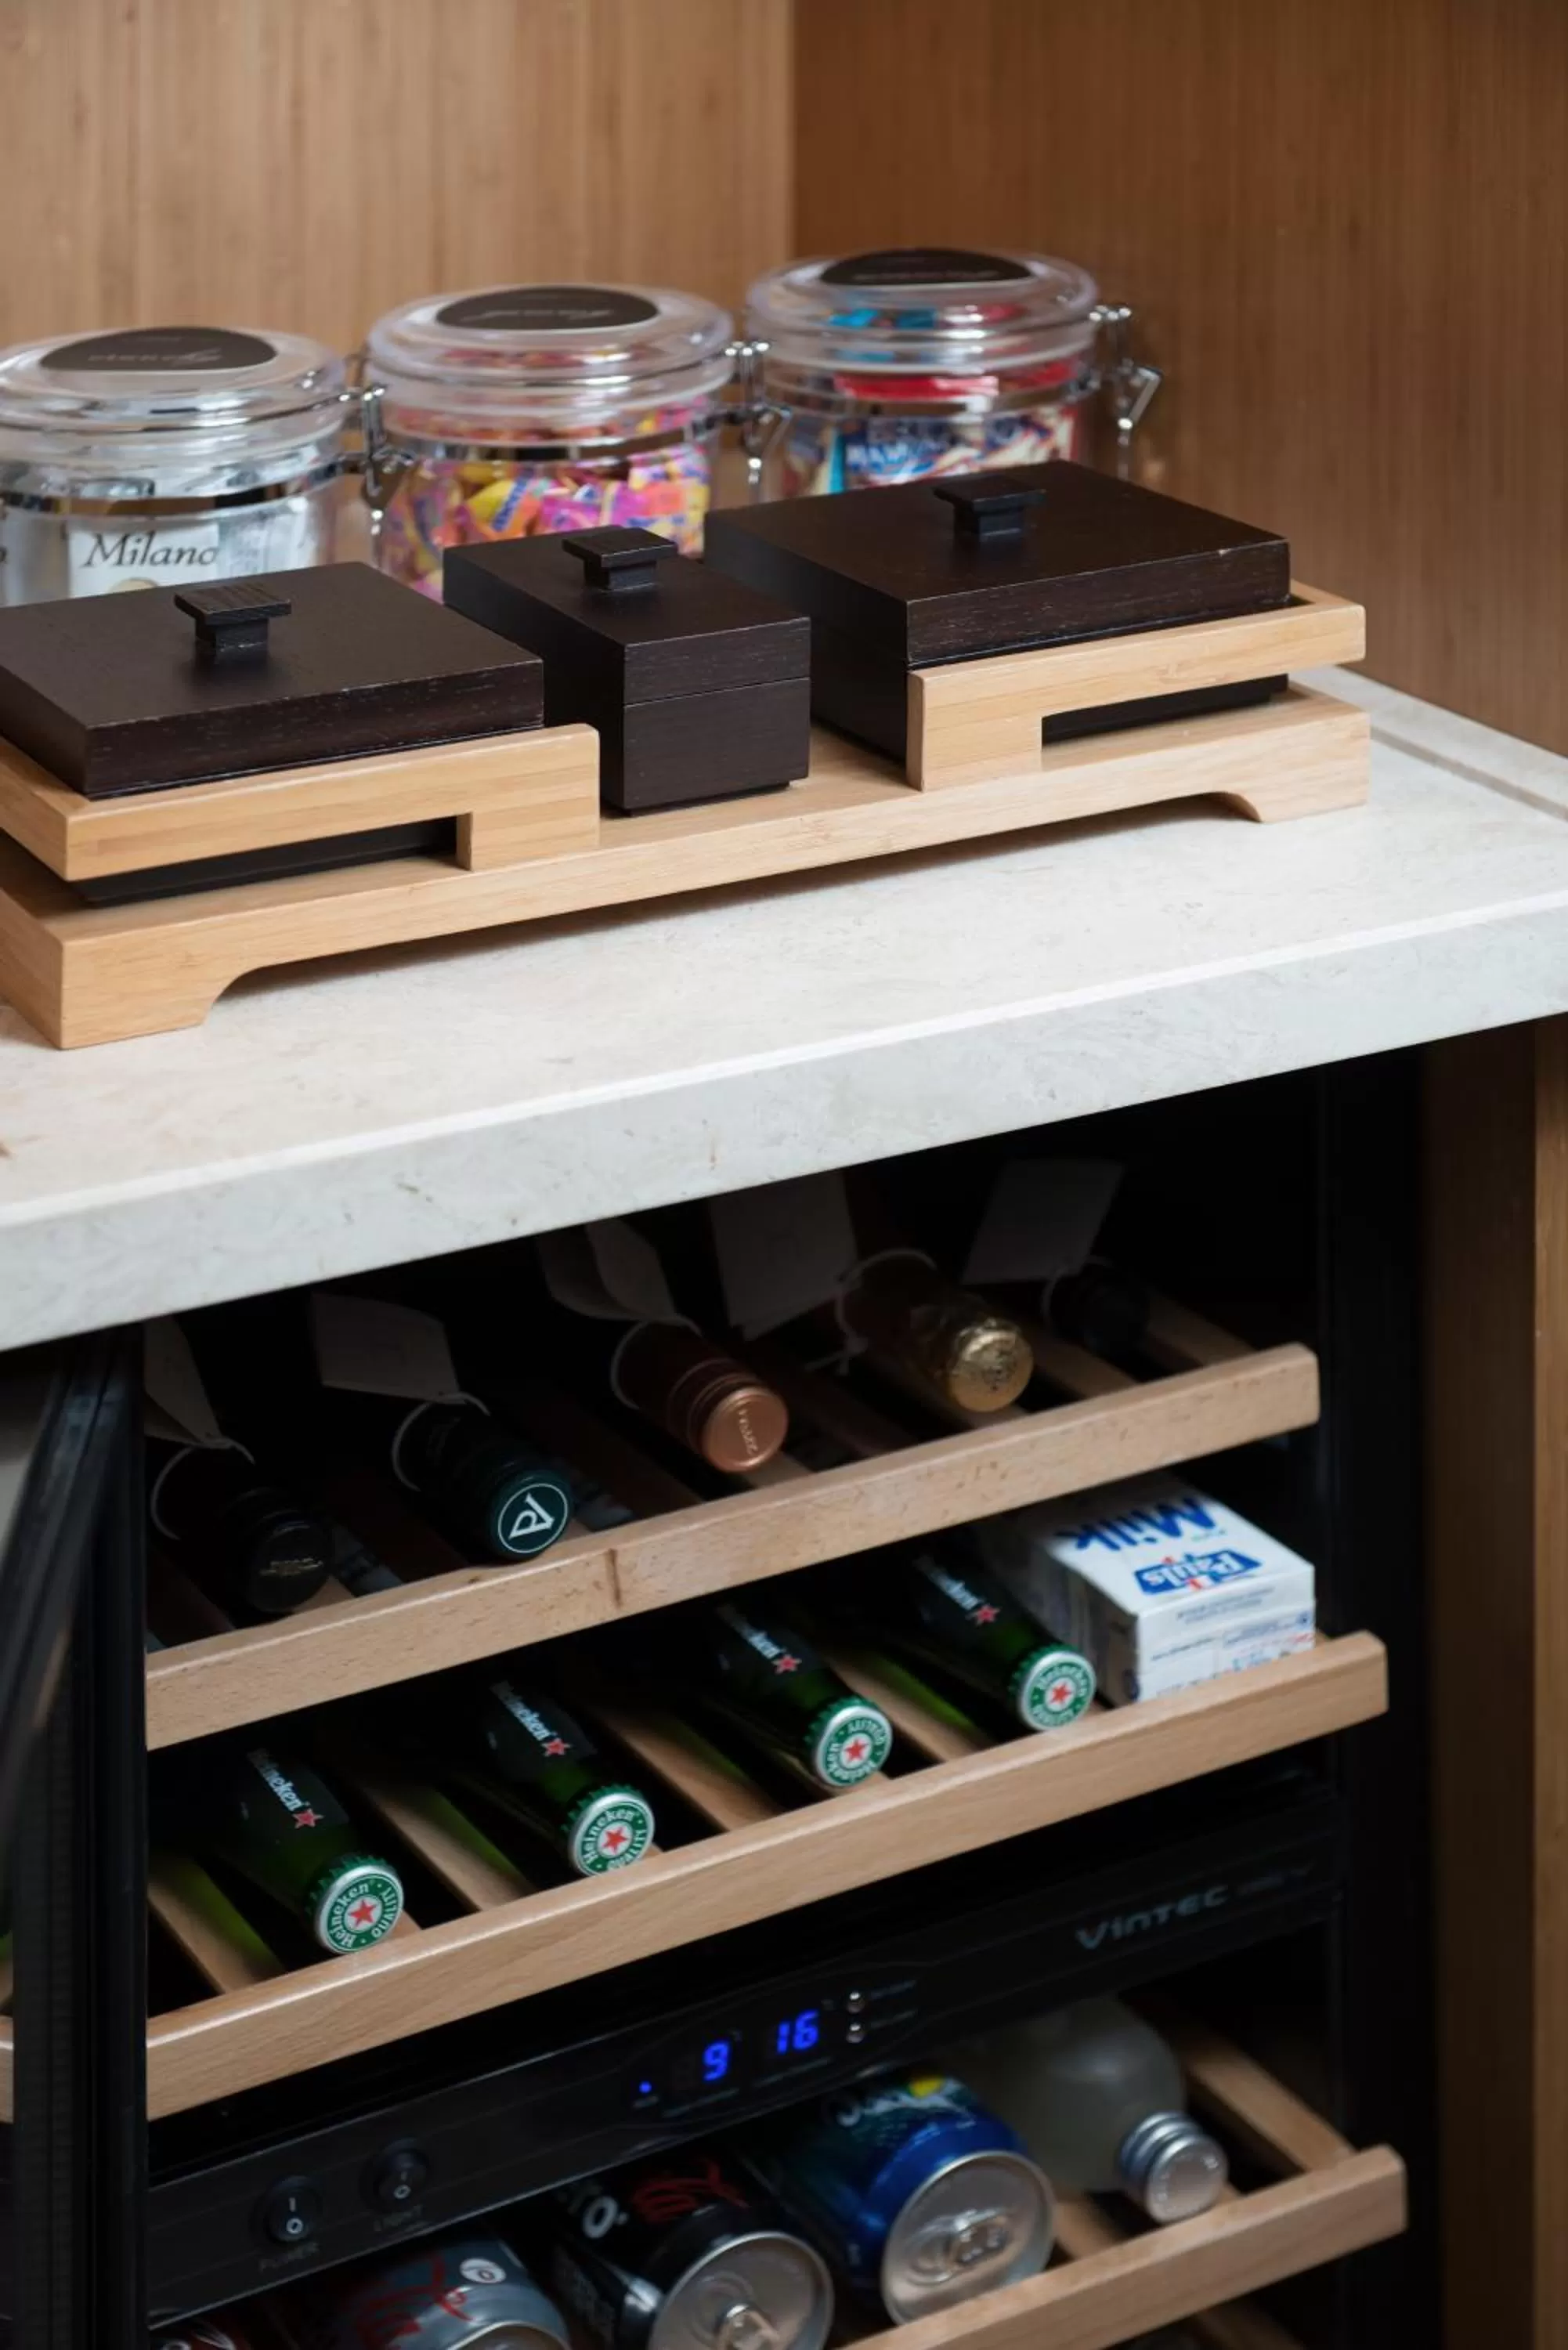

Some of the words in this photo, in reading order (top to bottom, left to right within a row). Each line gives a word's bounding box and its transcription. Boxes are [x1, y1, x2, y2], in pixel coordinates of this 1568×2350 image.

[81, 530, 220, 568] Milano
[1054, 1497, 1216, 1551] Milk
[489, 1680, 556, 1741] ineken
[330, 1882, 370, 1948] Heineken
[776, 2010, 819, 2055] 16
[703, 2042, 729, 2081] 9
